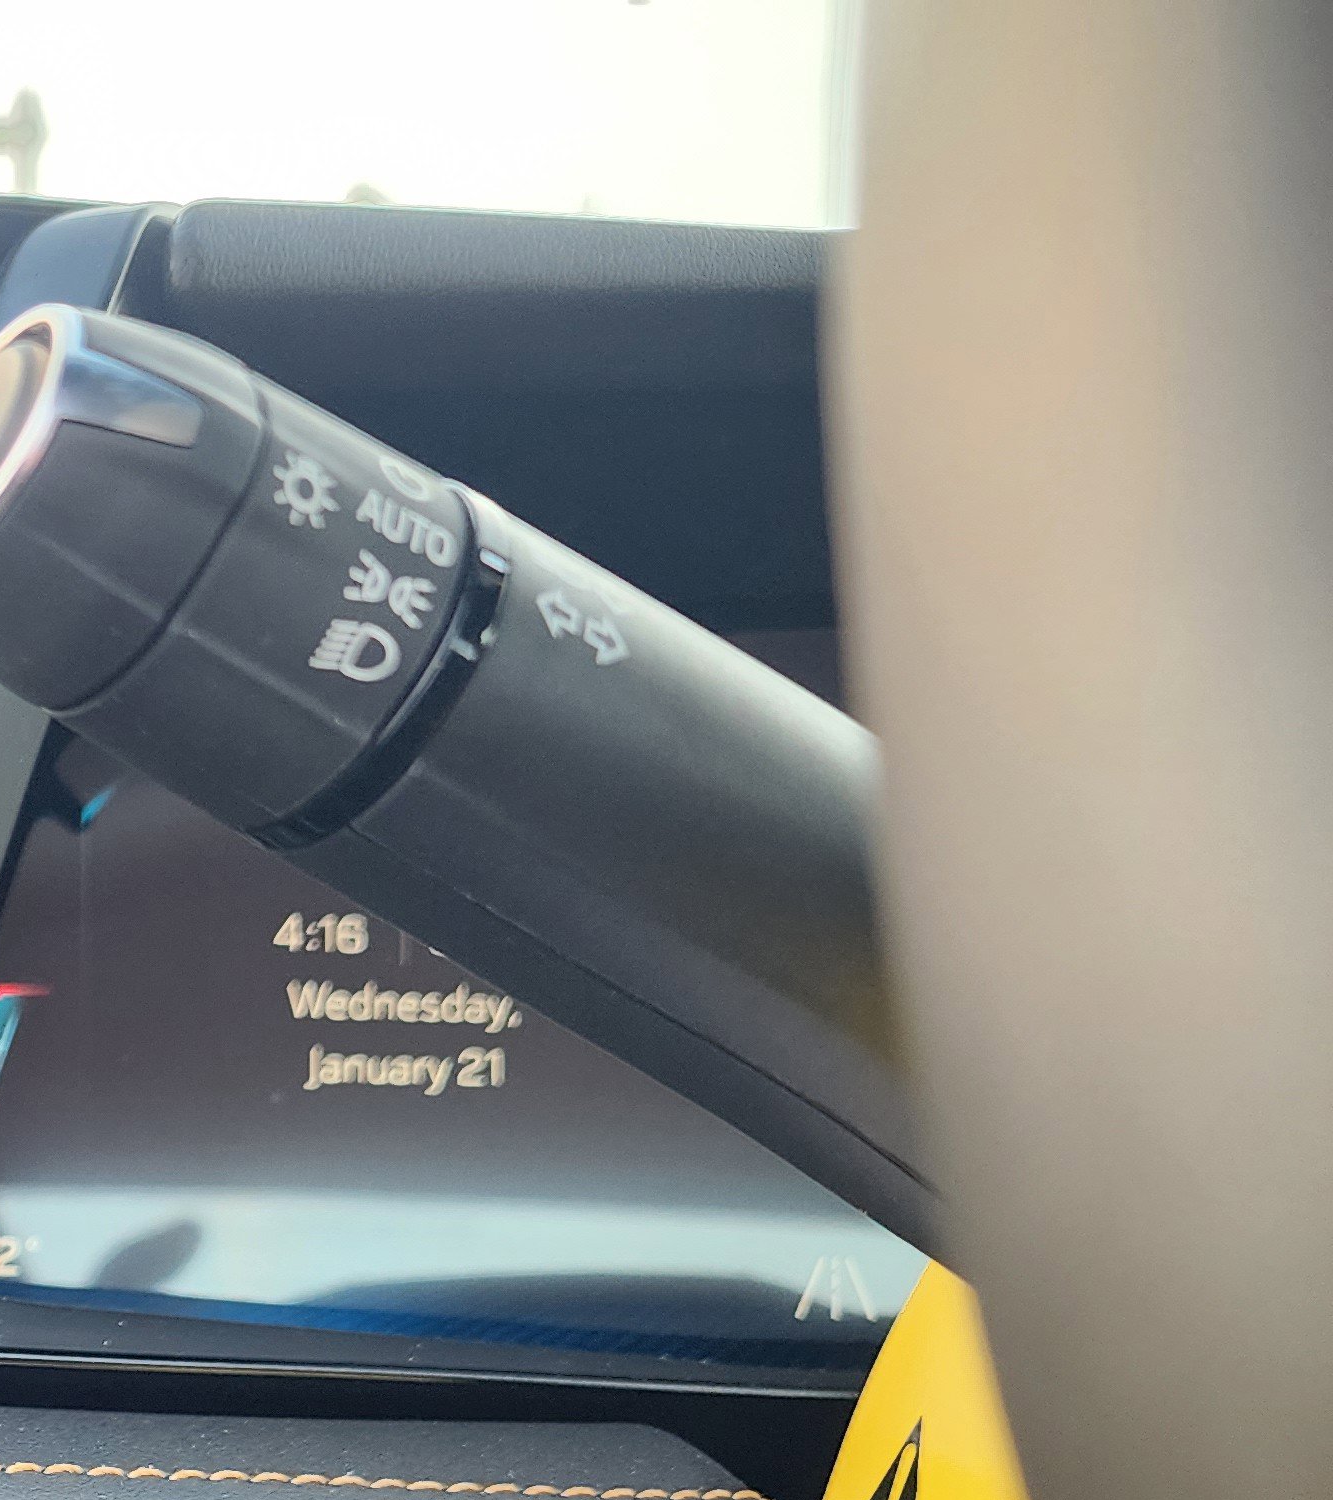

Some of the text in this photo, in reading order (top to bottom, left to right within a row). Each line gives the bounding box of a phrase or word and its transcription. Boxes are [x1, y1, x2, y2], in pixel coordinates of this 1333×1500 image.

[356, 488, 458, 568] AUTO
[273, 912, 370, 955] 4:16
[303, 1043, 506, 1096] January 21
